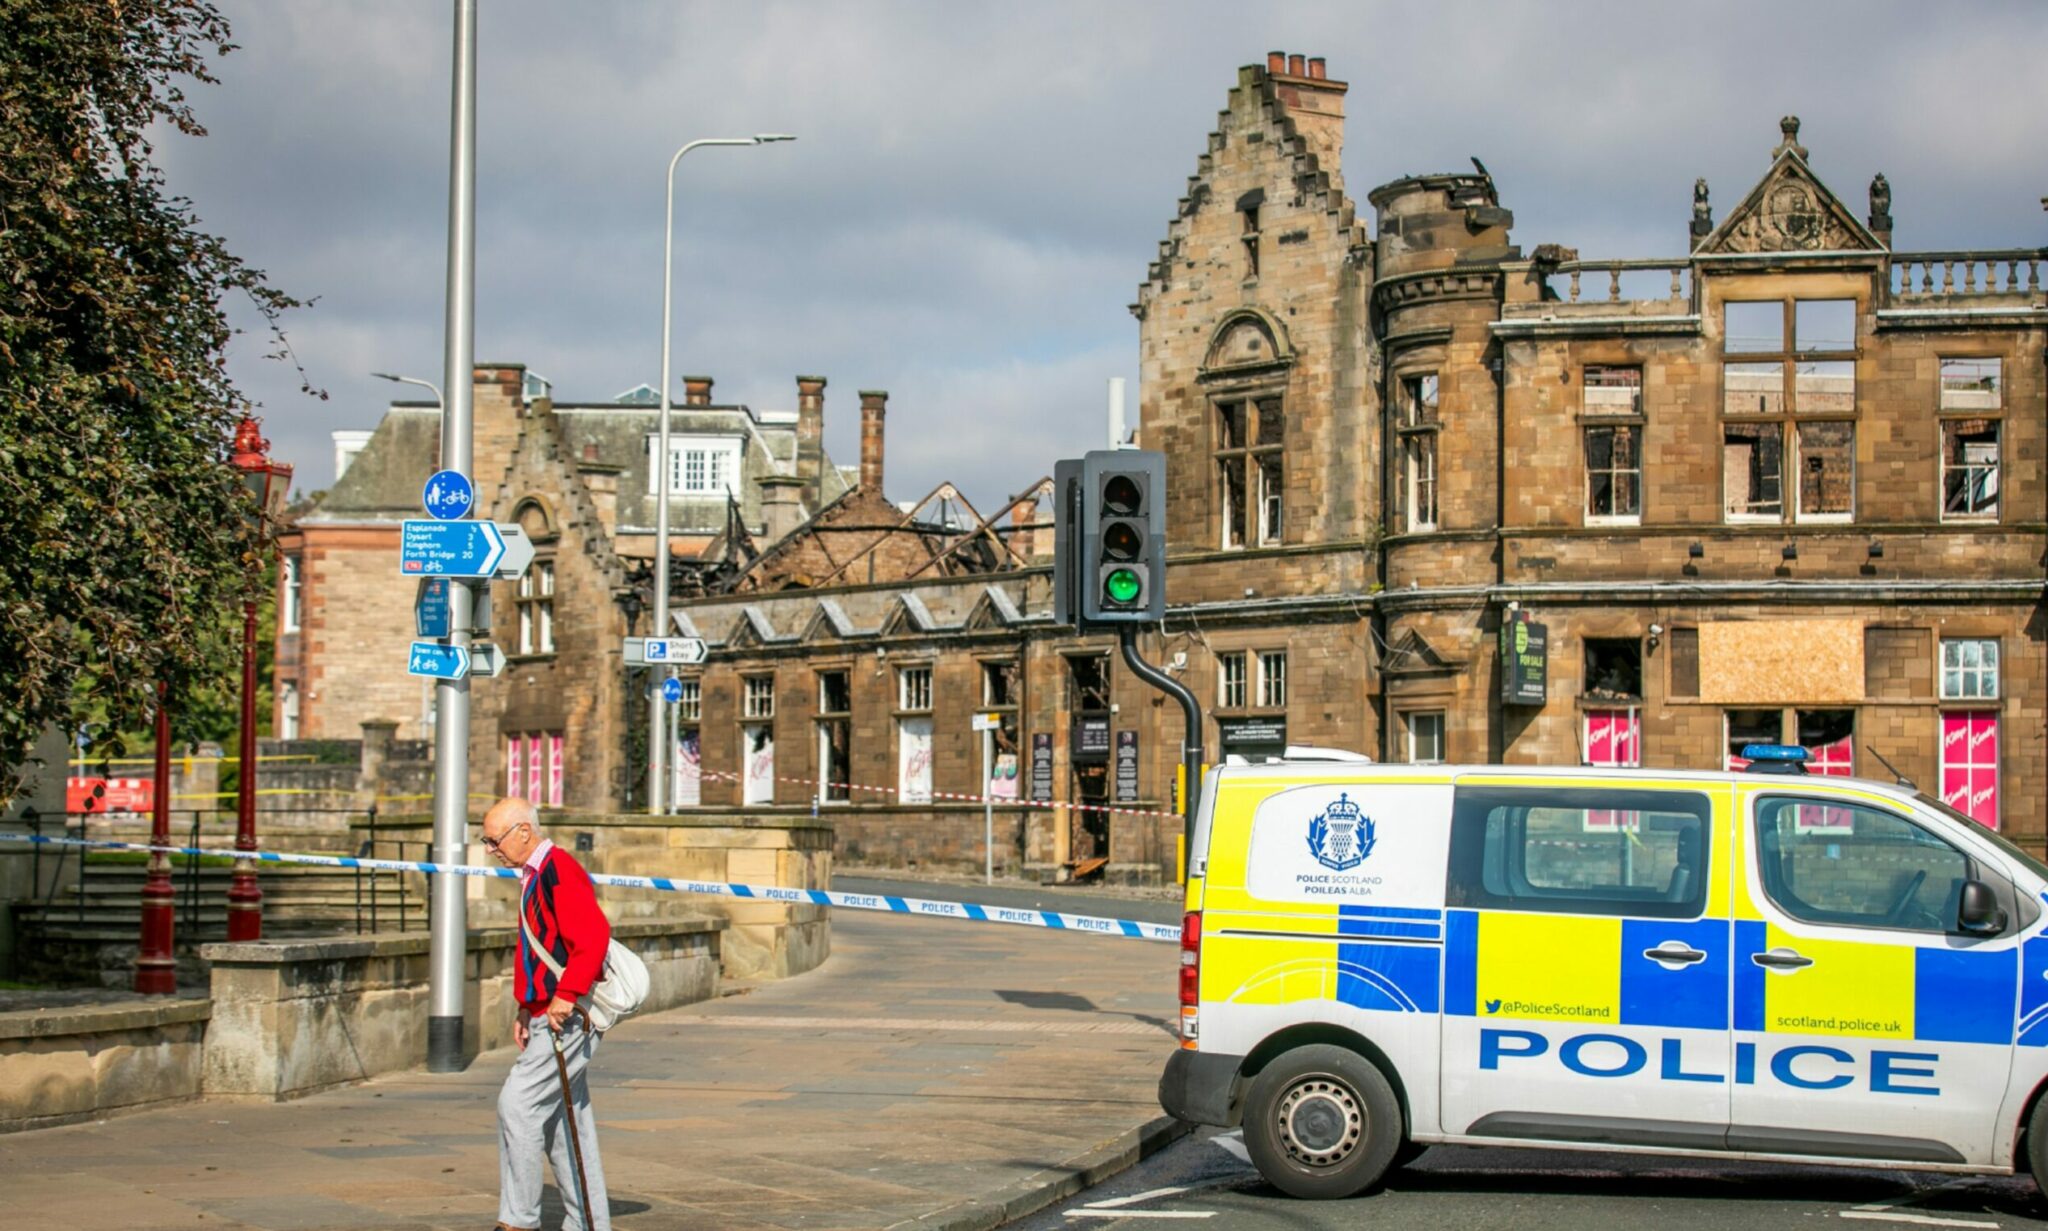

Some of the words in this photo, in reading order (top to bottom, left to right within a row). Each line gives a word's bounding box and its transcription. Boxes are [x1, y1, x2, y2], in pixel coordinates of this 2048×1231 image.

[406, 524, 447, 533] Esplanade
[406, 533, 432, 541] Dysart
[467, 533, 474, 541] 3
[406, 542, 441, 550] Kinghorn
[467, 541, 474, 550] 5
[405, 550, 427, 558] Forth
[429, 550, 456, 560] Bridge
[462, 551, 474, 559] 20
[670, 641, 693, 649] Short
[414, 645, 431, 654] Town
[432, 648, 454, 658] cene
[672, 652, 689, 660] stay
[1520, 654, 1530, 667] FOR
[1530, 655, 1543, 667] SALE
[1296, 874, 1330, 883] POLICE
[1331, 875, 1383, 885] SCOTLAND
[1304, 886, 1347, 895] POILEAS
[1349, 887, 1372, 895] ALBA
[610, 877, 644, 888] POLICE
[688, 882, 722, 894] POLICE
[766, 889, 800, 900] POLICE
[843, 895, 878, 907] POLICE
[921, 902, 956, 914] POLICE
[999, 910, 1033, 922] POLICE
[1076, 918, 1111, 931] POLICE
[1154, 926, 1181, 939] POLIC
[1503, 1001, 1610, 1018] @PoliceScotland
[1777, 1016, 1902, 1032] scotland.police.uk
[1479, 1028, 1940, 1096] POLICE
